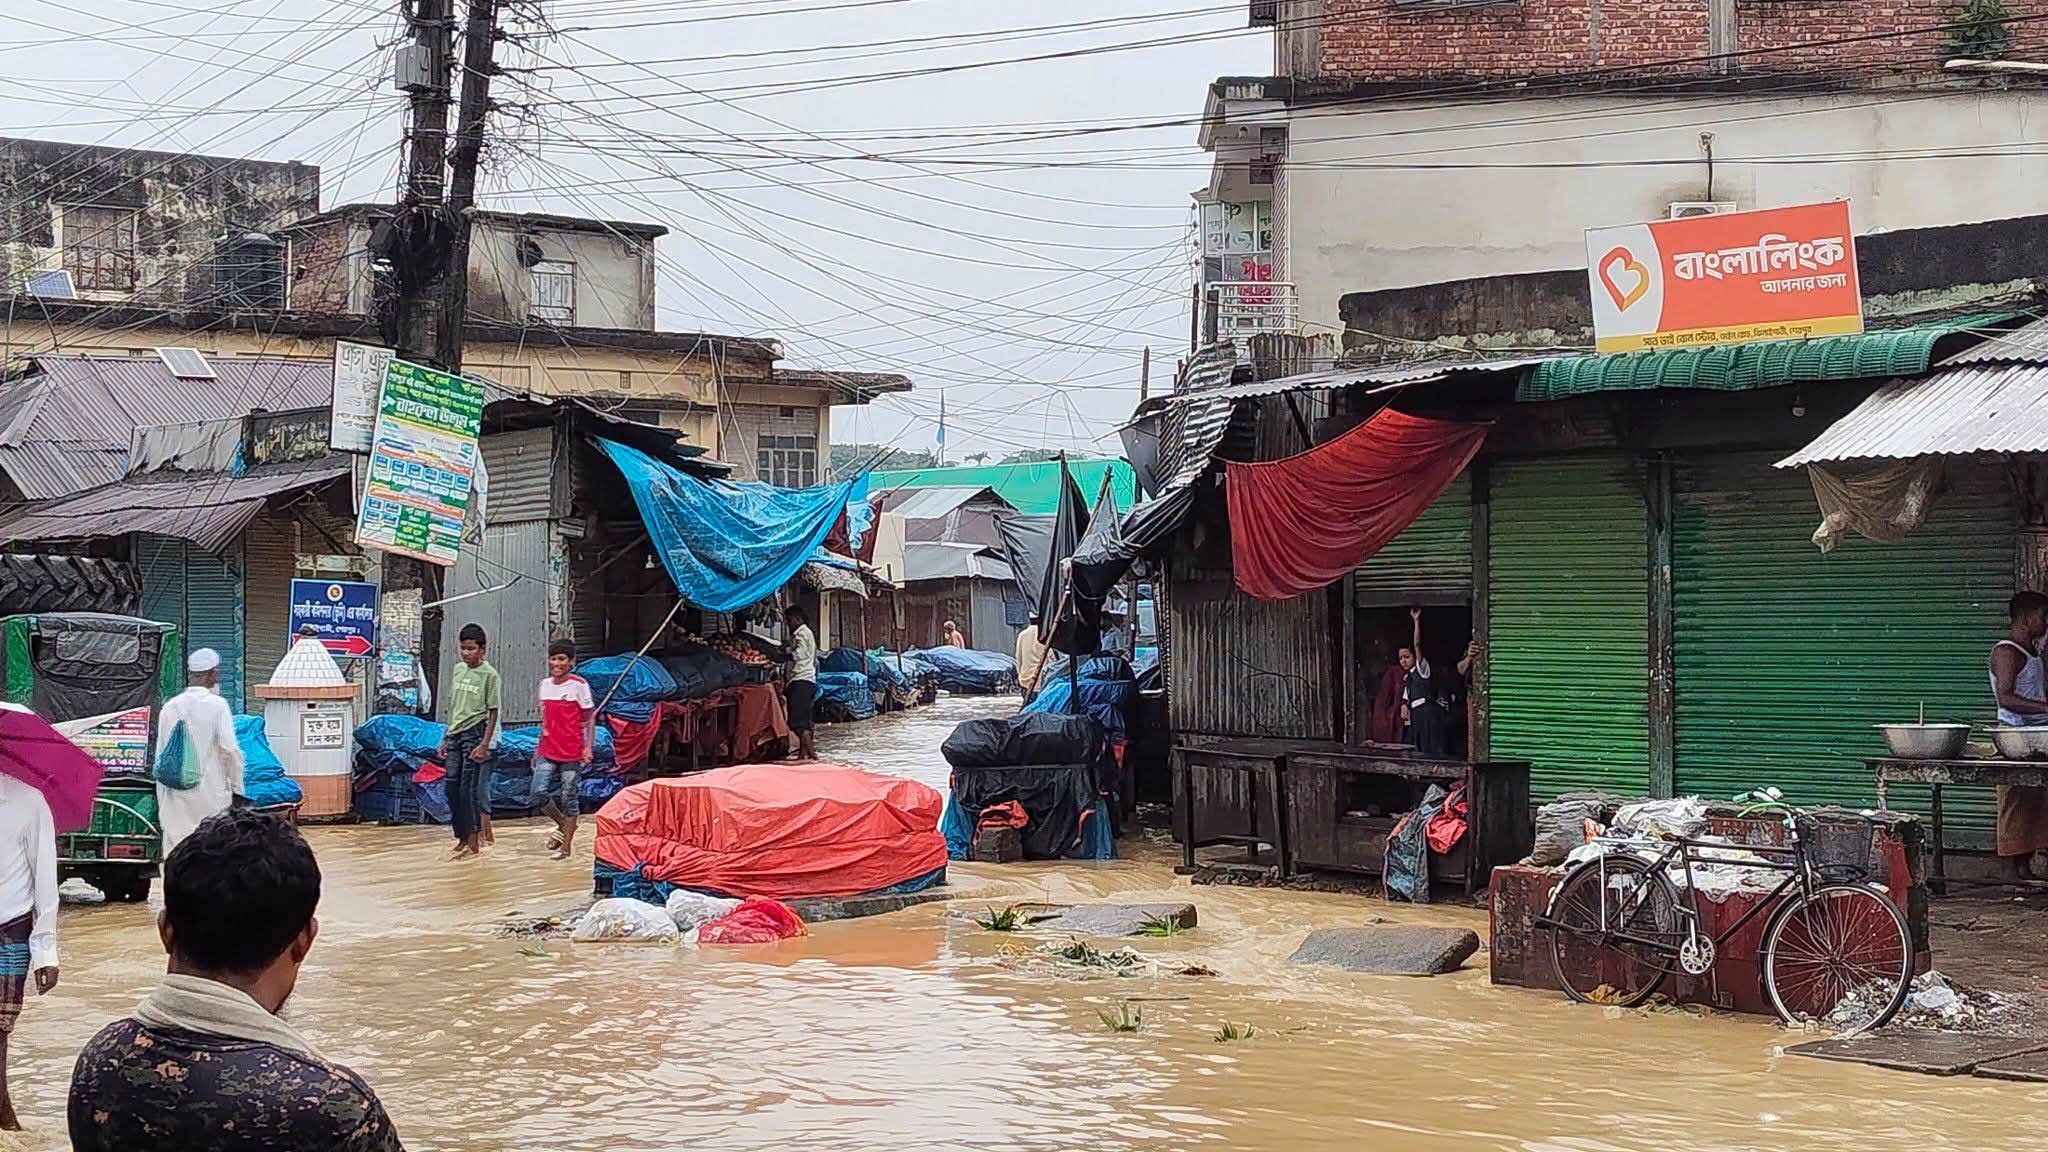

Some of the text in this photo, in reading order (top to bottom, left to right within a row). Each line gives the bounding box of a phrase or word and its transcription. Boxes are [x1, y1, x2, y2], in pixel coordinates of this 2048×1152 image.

[1673, 234, 1844, 280] বাংলালিংক
[1760, 273, 1847, 293] আপনার জন্য
